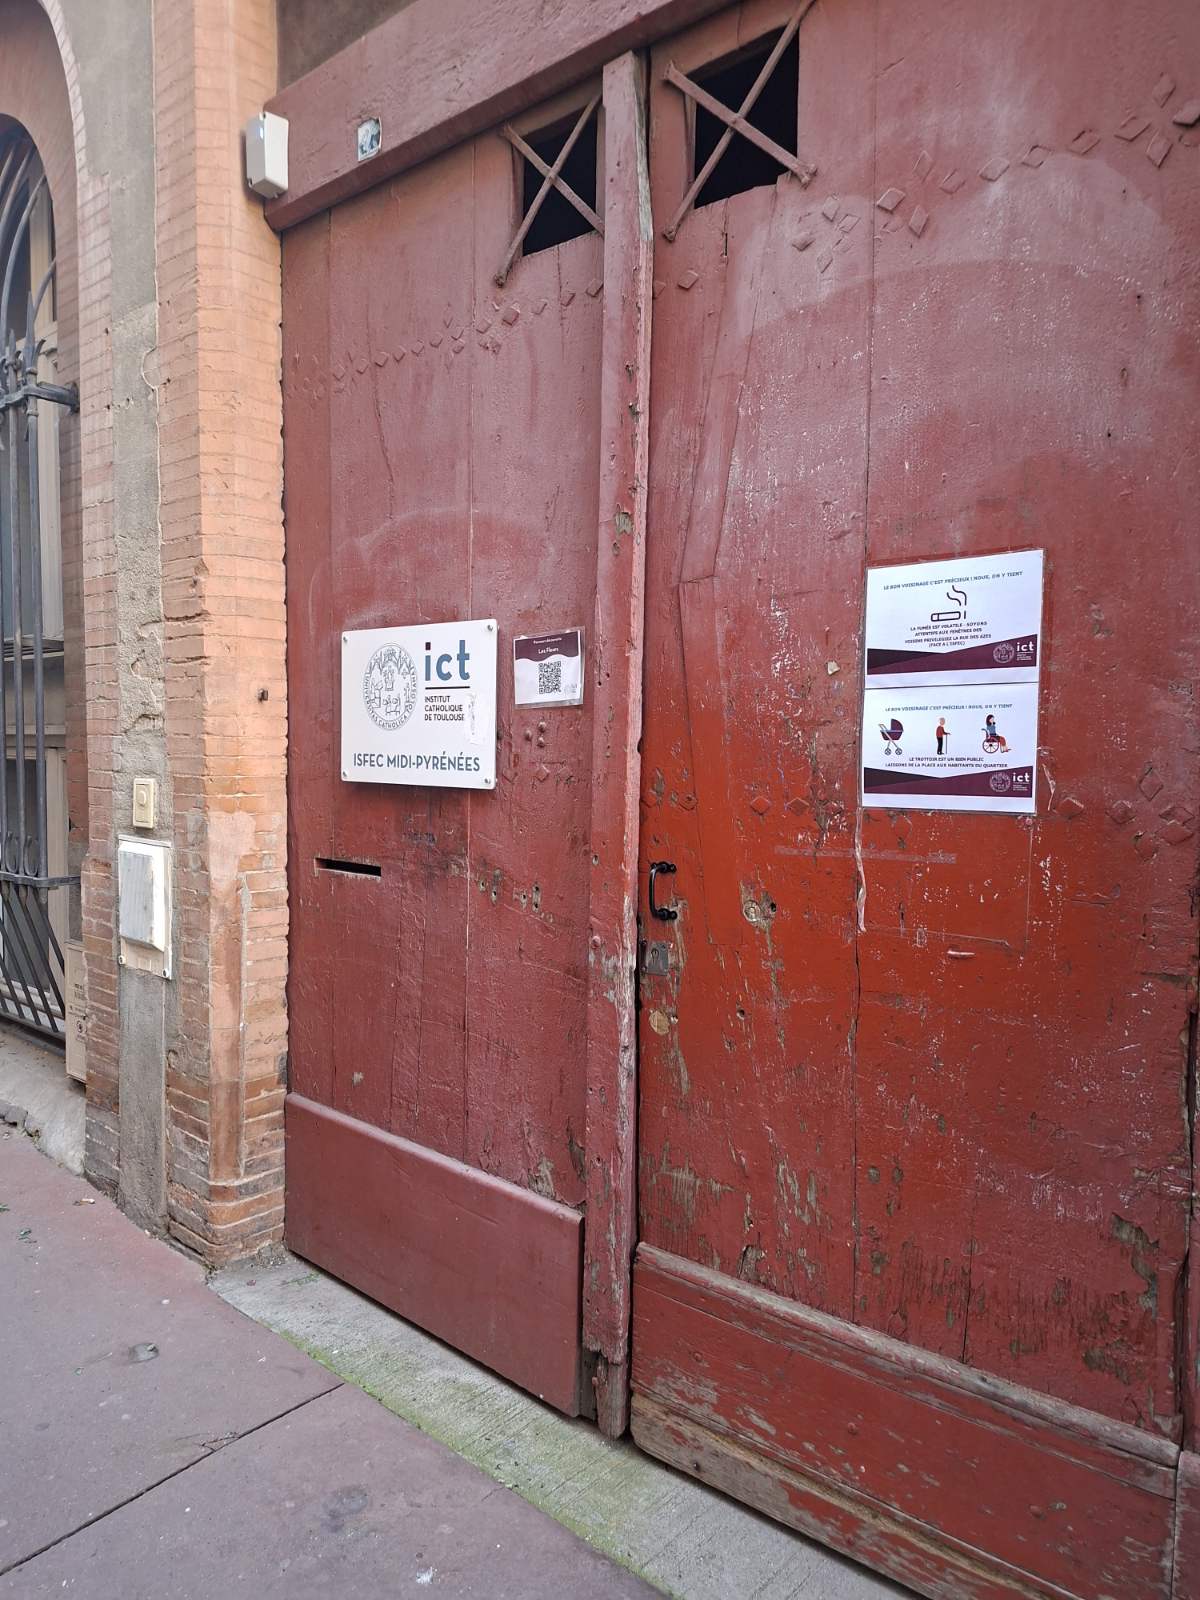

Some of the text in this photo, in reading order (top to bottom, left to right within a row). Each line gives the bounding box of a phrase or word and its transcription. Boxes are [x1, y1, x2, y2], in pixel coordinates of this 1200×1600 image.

[1016, 641, 1034, 652] ict
[424, 640, 470, 681] ict
[353, 751, 480, 772] ISFEC MIDI-PYRÉNÉES
[1012, 772, 1030, 782] ict
